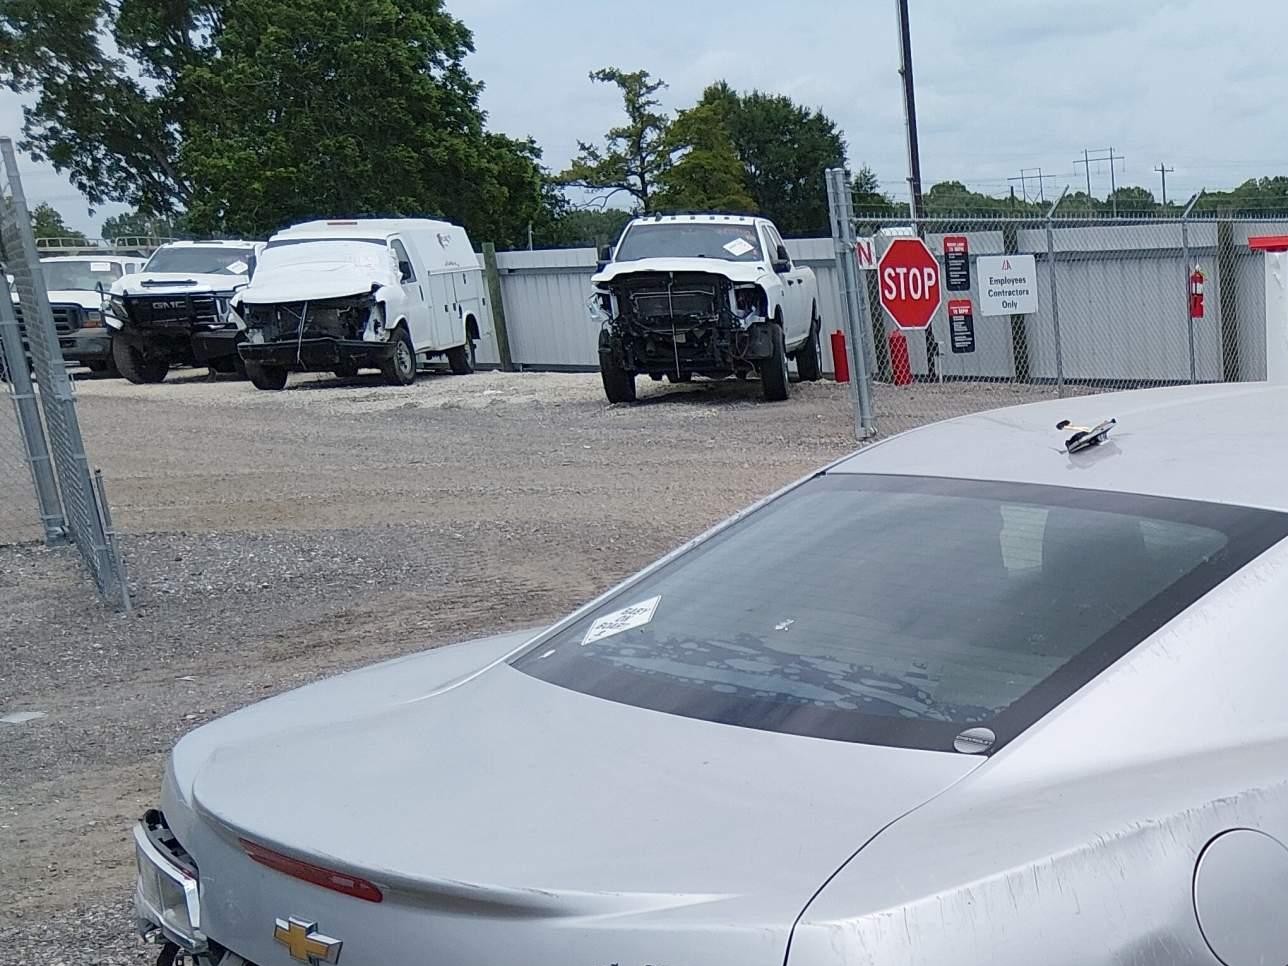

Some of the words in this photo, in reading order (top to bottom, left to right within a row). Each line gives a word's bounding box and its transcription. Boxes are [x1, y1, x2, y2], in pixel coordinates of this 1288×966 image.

[884, 267, 936, 300] STOP
[989, 276, 1026, 286] Employees
[988, 289, 1029, 298] Contractors
[152, 301, 186, 310] GMC
[1002, 300, 1018, 310] Only
